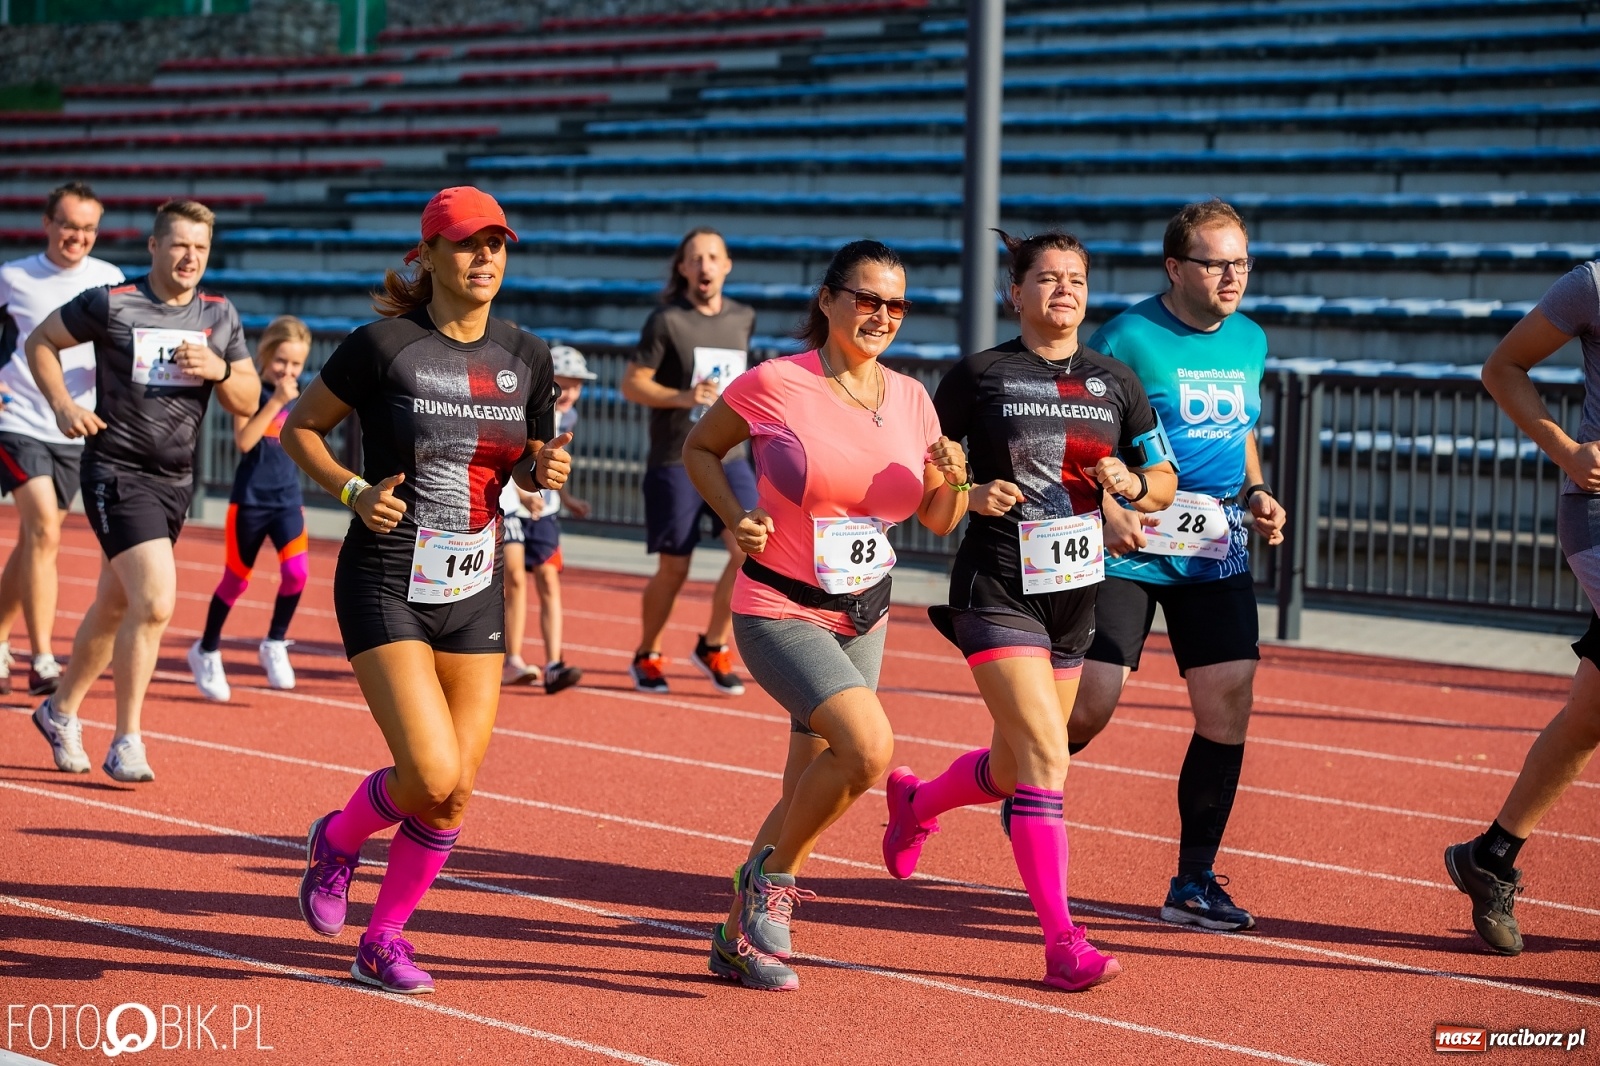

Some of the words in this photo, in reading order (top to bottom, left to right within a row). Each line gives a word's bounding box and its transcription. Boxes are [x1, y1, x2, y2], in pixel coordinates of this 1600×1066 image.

[413, 398, 526, 421] RUNMAGEDDON
[1002, 402, 1115, 424] RUNMAGEDDON
[1180, 383, 1250, 425] bbl
[1177, 512, 1206, 534] 28
[850, 538, 876, 564] 83
[1051, 535, 1089, 564] 148
[446, 549, 484, 578] 140
[488, 632, 501, 640] 4F
